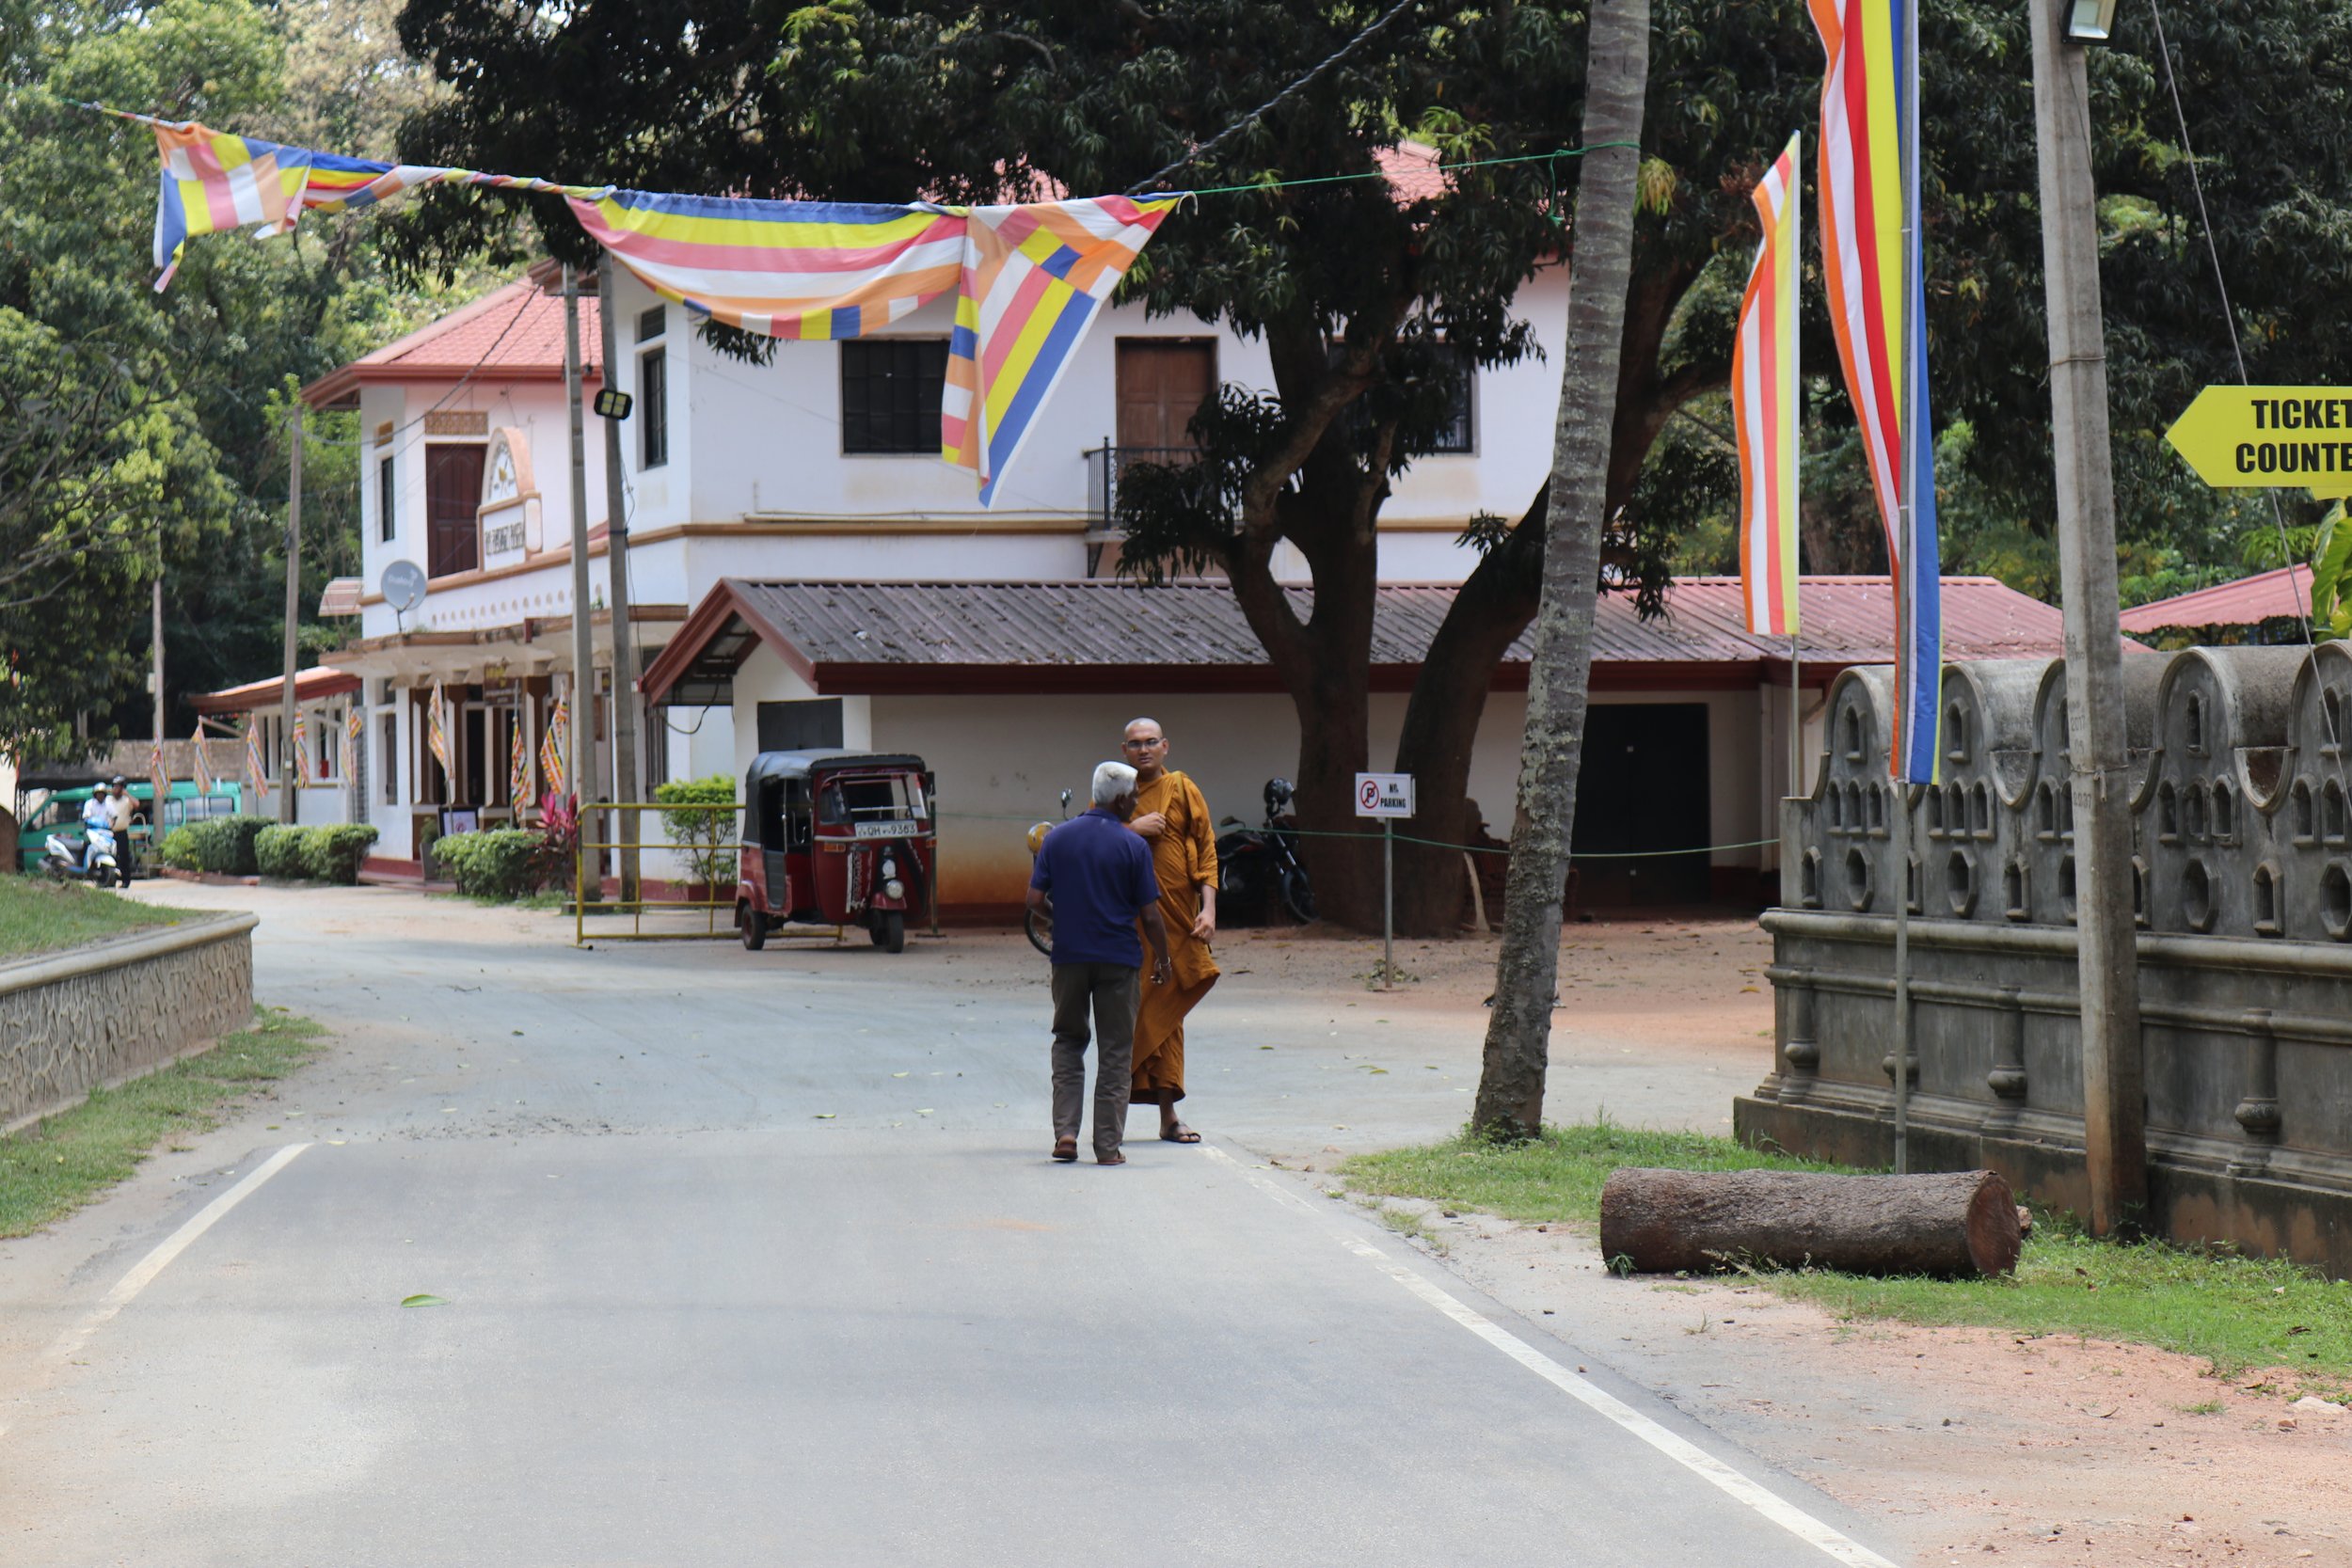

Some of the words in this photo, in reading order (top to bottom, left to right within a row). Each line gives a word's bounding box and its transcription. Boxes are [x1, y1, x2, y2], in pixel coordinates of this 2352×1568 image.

[2251, 399, 2352, 429] TICKET
[1380, 798, 1406, 807] PARKING
[892, 823, 915, 835] 9363
